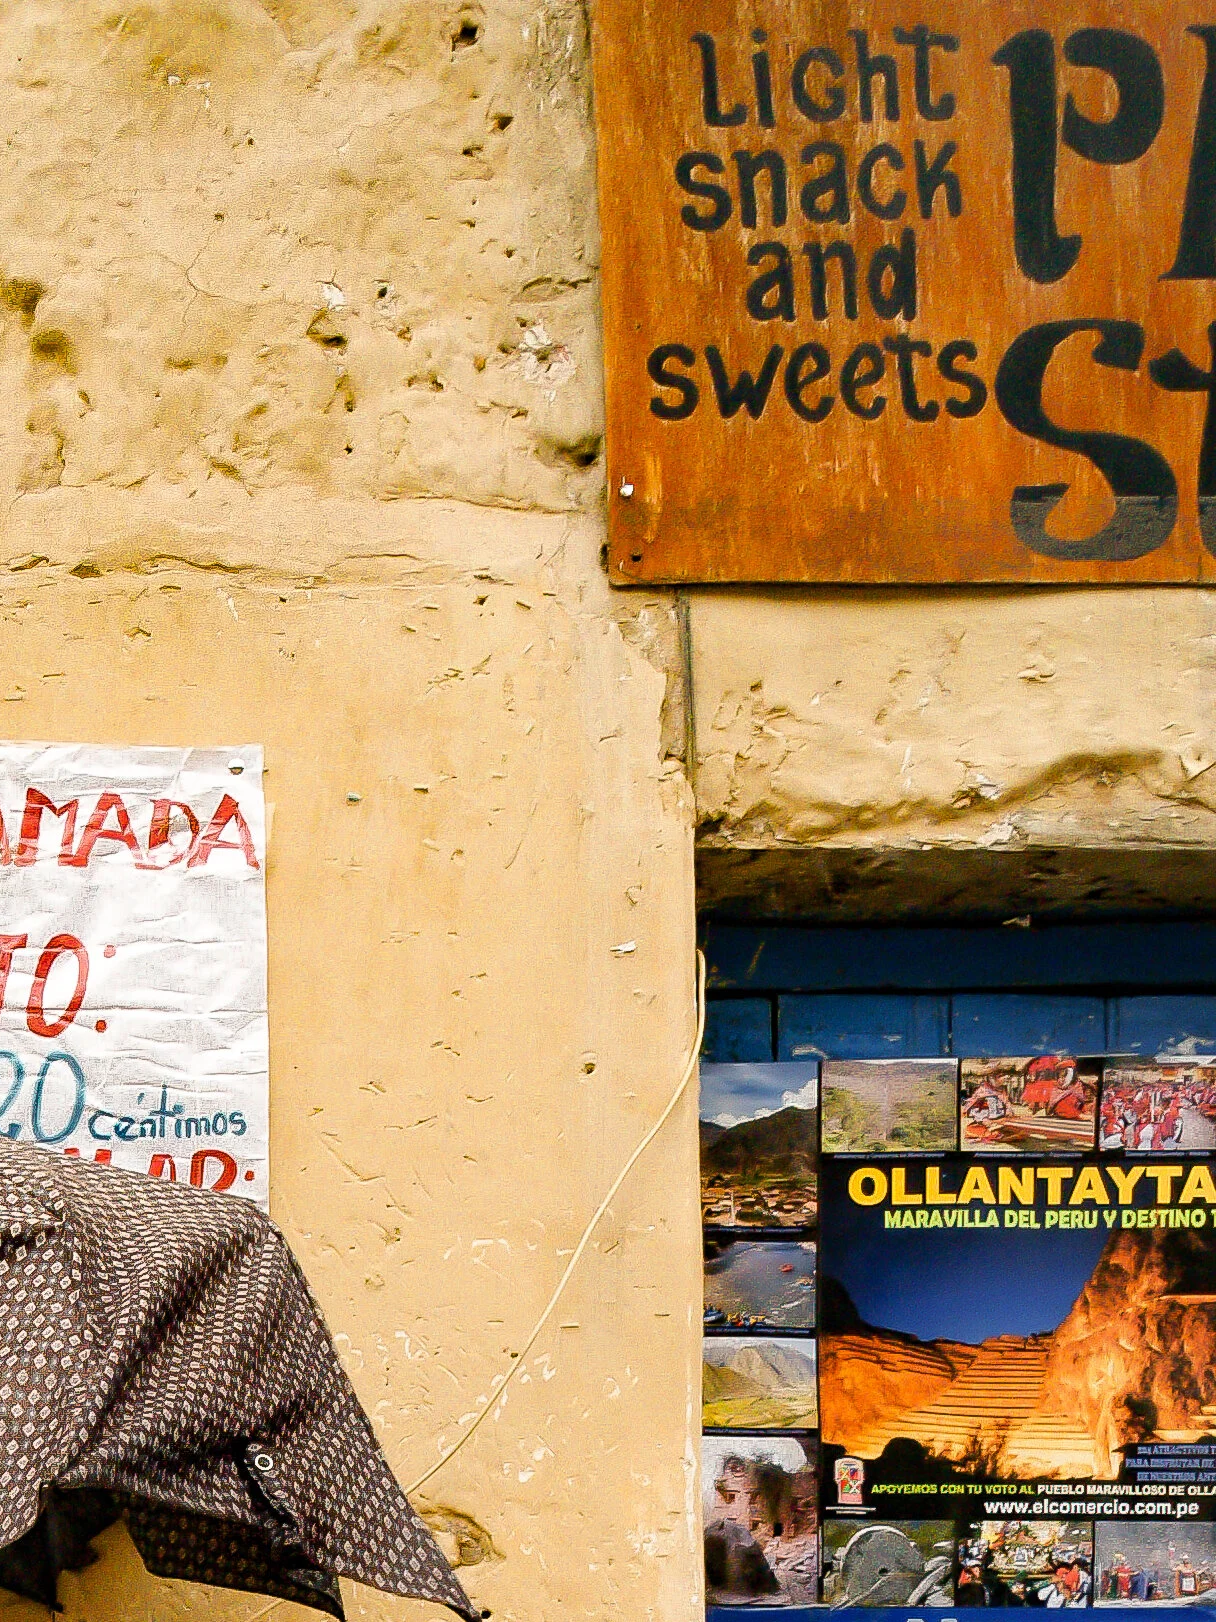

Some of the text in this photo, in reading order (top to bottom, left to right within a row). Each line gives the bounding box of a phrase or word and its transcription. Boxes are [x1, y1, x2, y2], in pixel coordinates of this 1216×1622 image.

[674, 139, 963, 232] snack
[744, 228, 918, 323] and
[646, 334, 988, 424] sweets
[87, 1083, 249, 1142] céntimos
[847, 1164, 1216, 1206] OLLANTAYTA
[884, 1210, 1000, 1229] MARAVILLA
[1004, 1210, 1041, 1229] DEL
[1045, 1209, 1098, 1230] PERU
[1102, 1209, 1118, 1229] Y
[1121, 1208, 1206, 1229] DESTINO
[871, 1484, 937, 1495] APOYEMOS
[940, 1484, 964, 1495] CON
[967, 1484, 983, 1495] TU
[985, 1484, 1017, 1495] VOTO
[1019, 1484, 1035, 1495] AL
[1037, 1484, 1085, 1495] PUEBLO
[1086, 1484, 1167, 1496] MARAVILLOSO
[1168, 1485, 1186, 1496] DE
[984, 1499, 1200, 1519] www.elcomercio.com.pe
